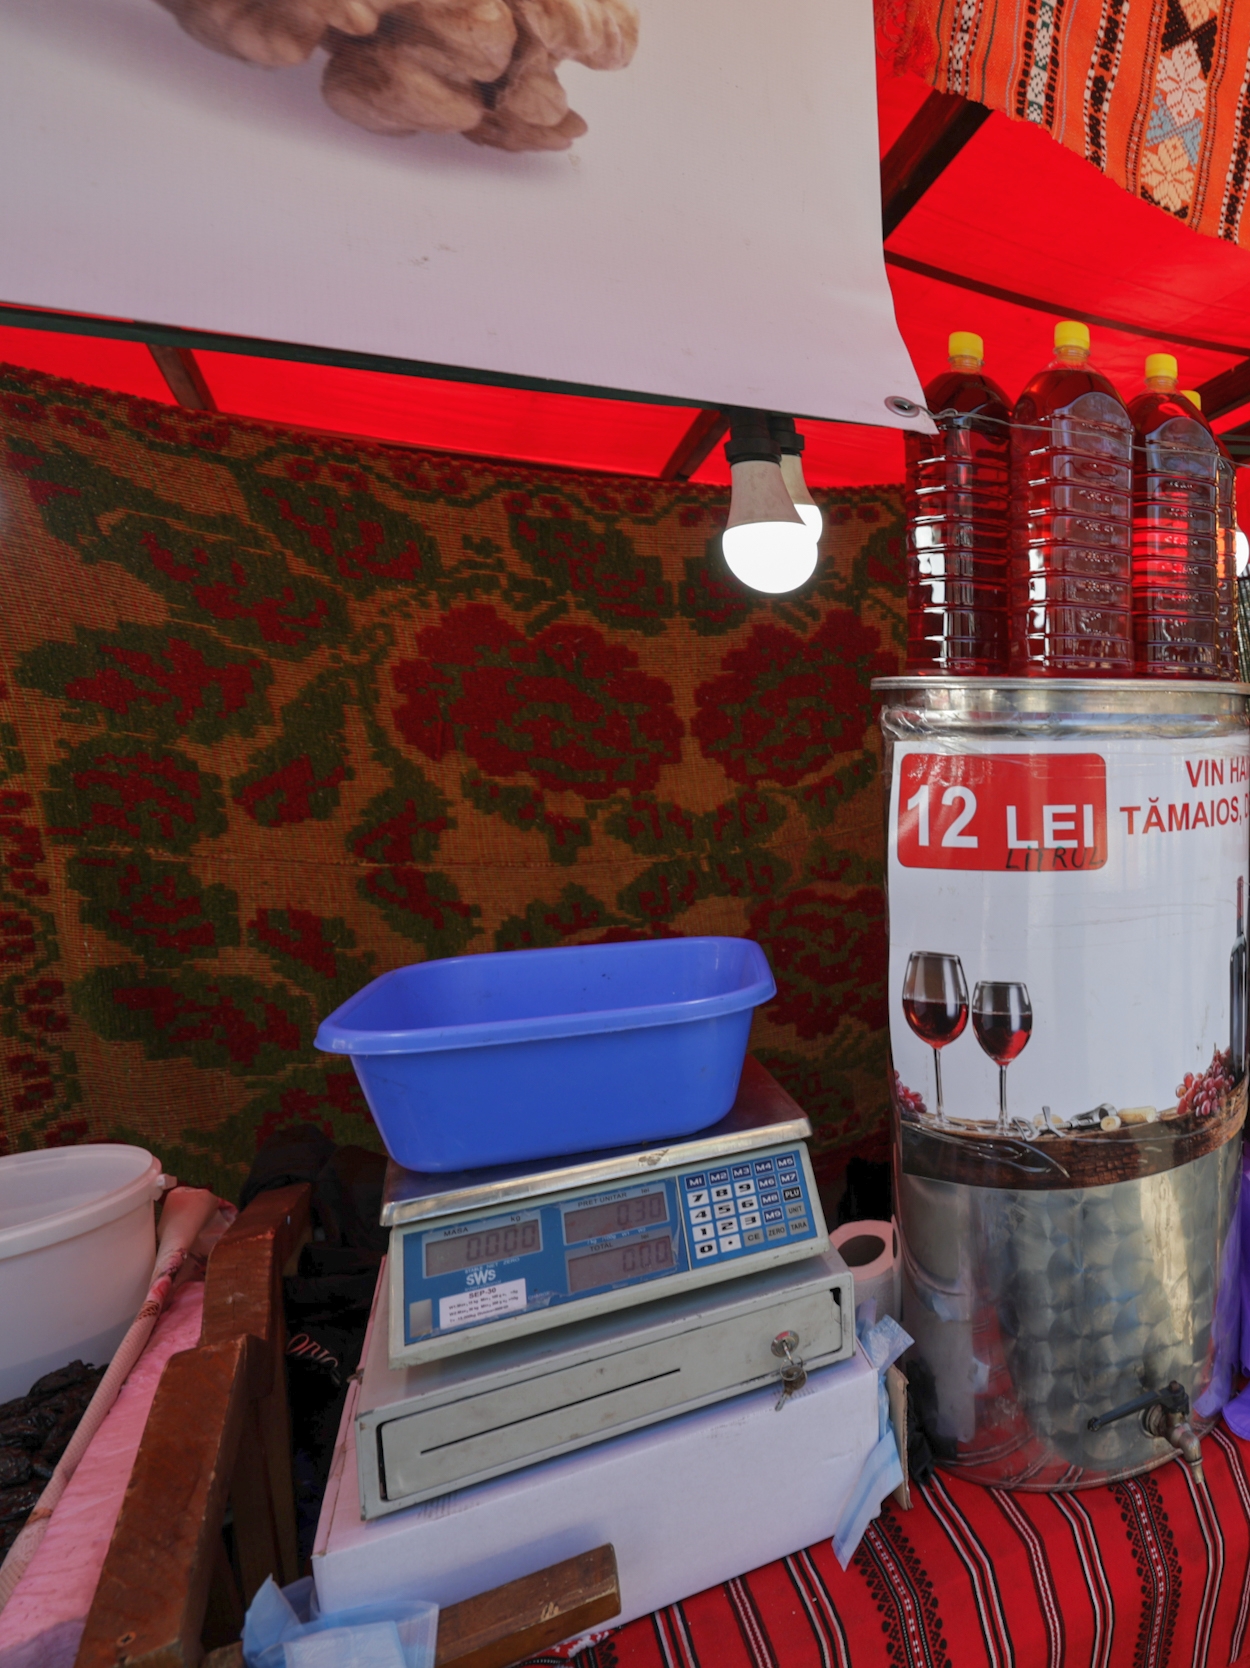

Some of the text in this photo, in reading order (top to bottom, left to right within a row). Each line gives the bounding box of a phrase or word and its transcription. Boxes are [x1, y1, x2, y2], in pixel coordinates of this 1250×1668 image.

[1185, 758, 1224, 788] VIN
[907, 785, 1094, 849] 12 LEI
[1119, 795, 1242, 835] TĂMAIOS,
[689, 1157, 794, 1186] M1 M2 M3 M4 M5
[599, 1191, 627, 1203] UNITAR
[692, 1173, 796, 1203] 7 8 9 M6 M7
[695, 1188, 800, 1219] 4 5 6 M8 PLU
[443, 1226, 469, 1238] MASA
[510, 1215, 521, 1223] kg
[700, 1205, 802, 1236] 1 2 3 M9 UNIT
[589, 1243, 613, 1252] TOTAL
[699, 1221, 807, 1254] 0 CE ZERO TARA
[466, 1269, 497, 1286] SWS
